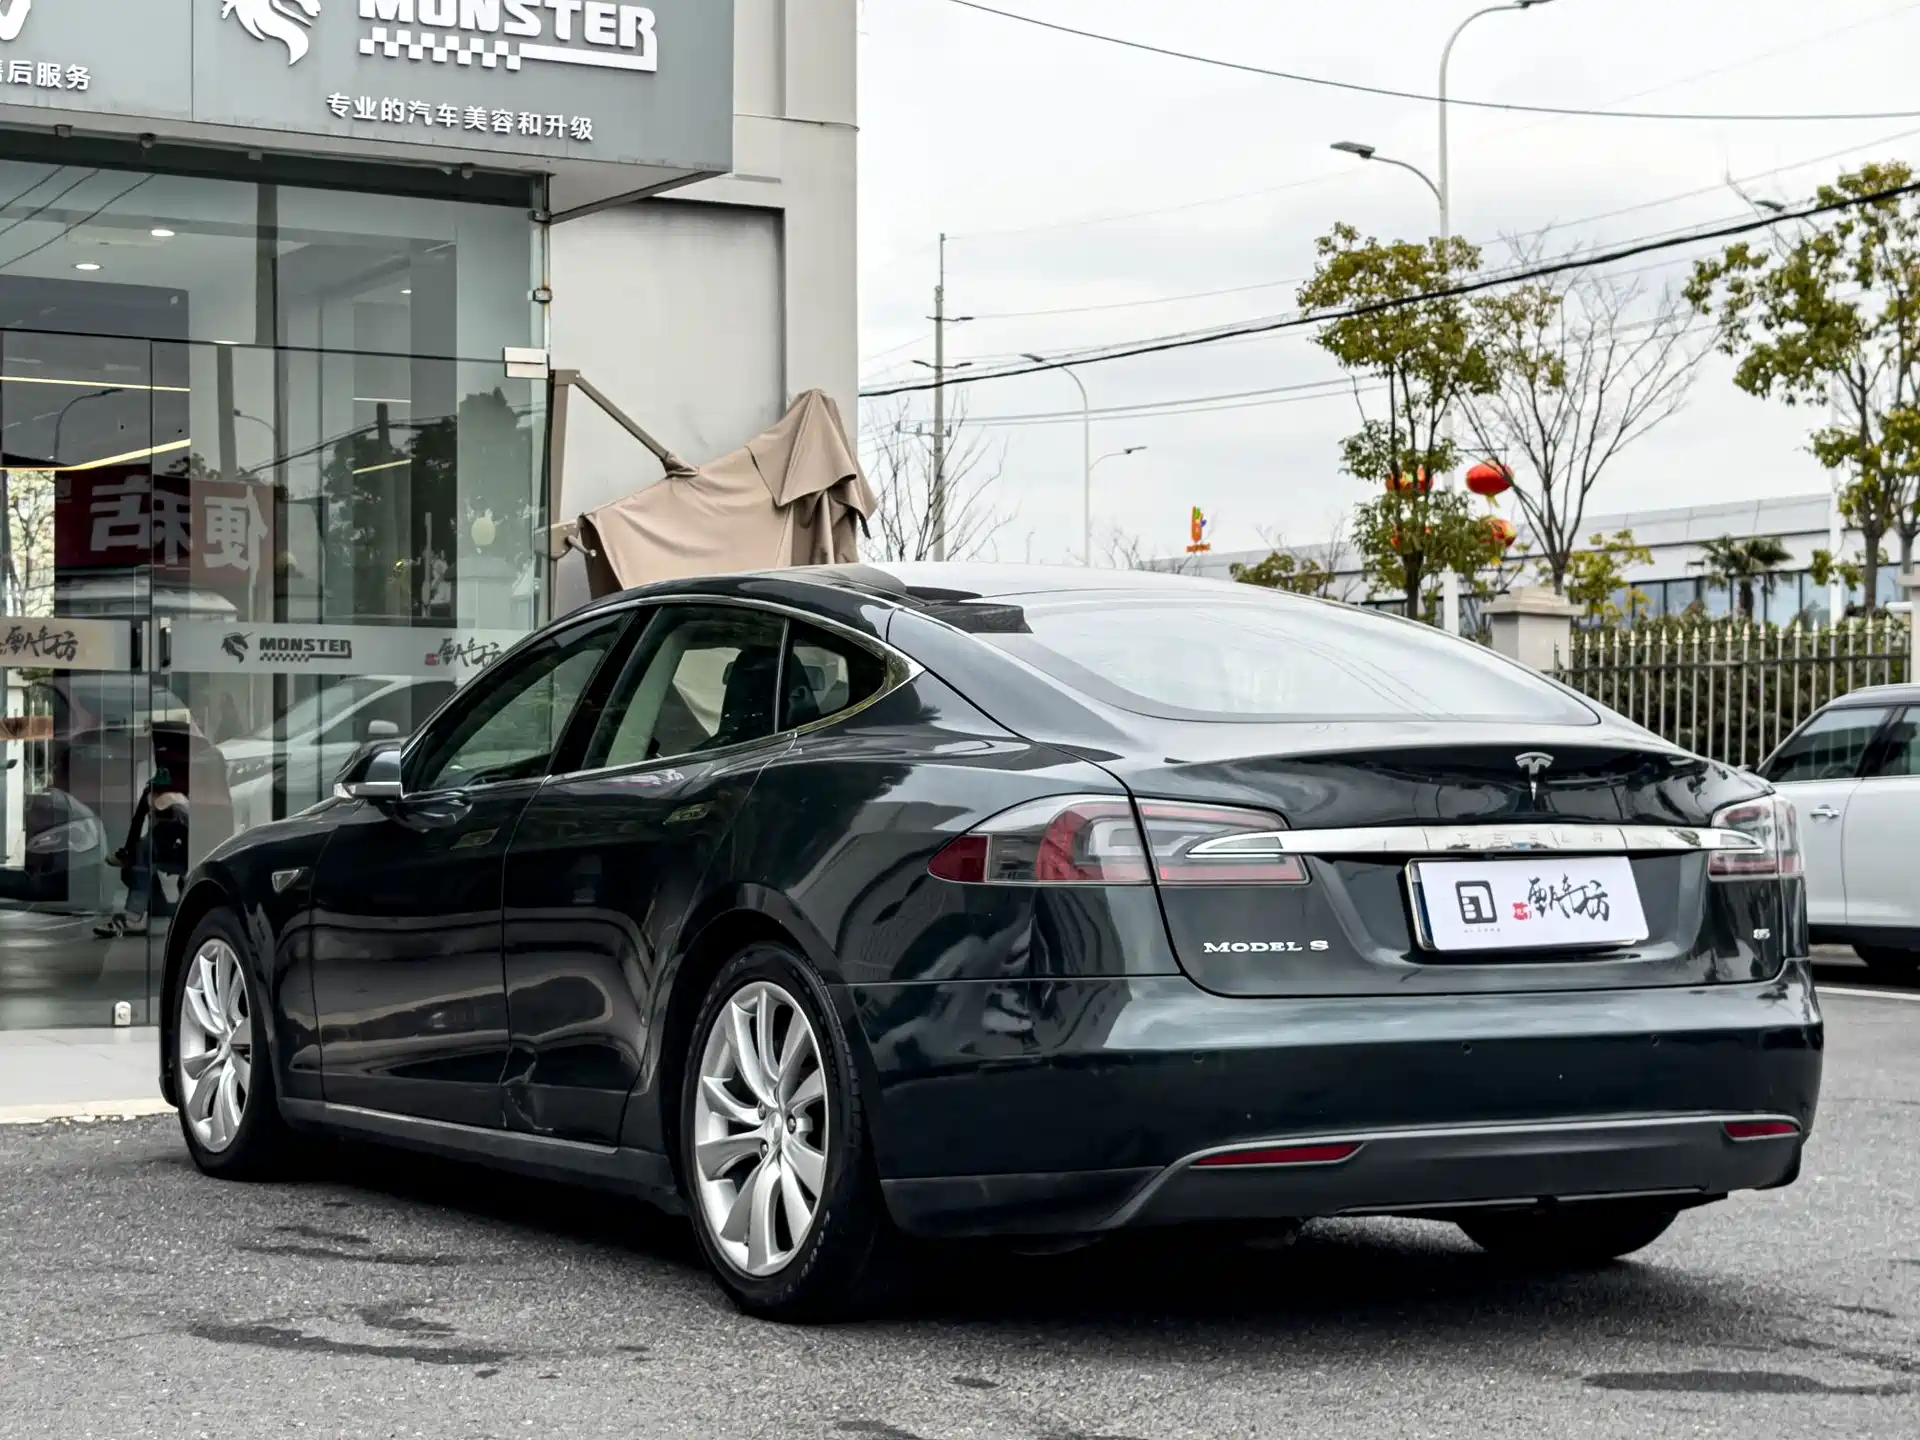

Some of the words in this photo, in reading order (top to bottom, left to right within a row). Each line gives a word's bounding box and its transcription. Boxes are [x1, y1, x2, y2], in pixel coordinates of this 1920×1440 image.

[0, 60, 91, 91] 后服务
[326, 92, 594, 141] 专业的汽车美容和升级
[259, 637, 352, 657] MONSTER
[1203, 941, 1303, 953] MODEL
[1309, 940, 1330, 951] S
